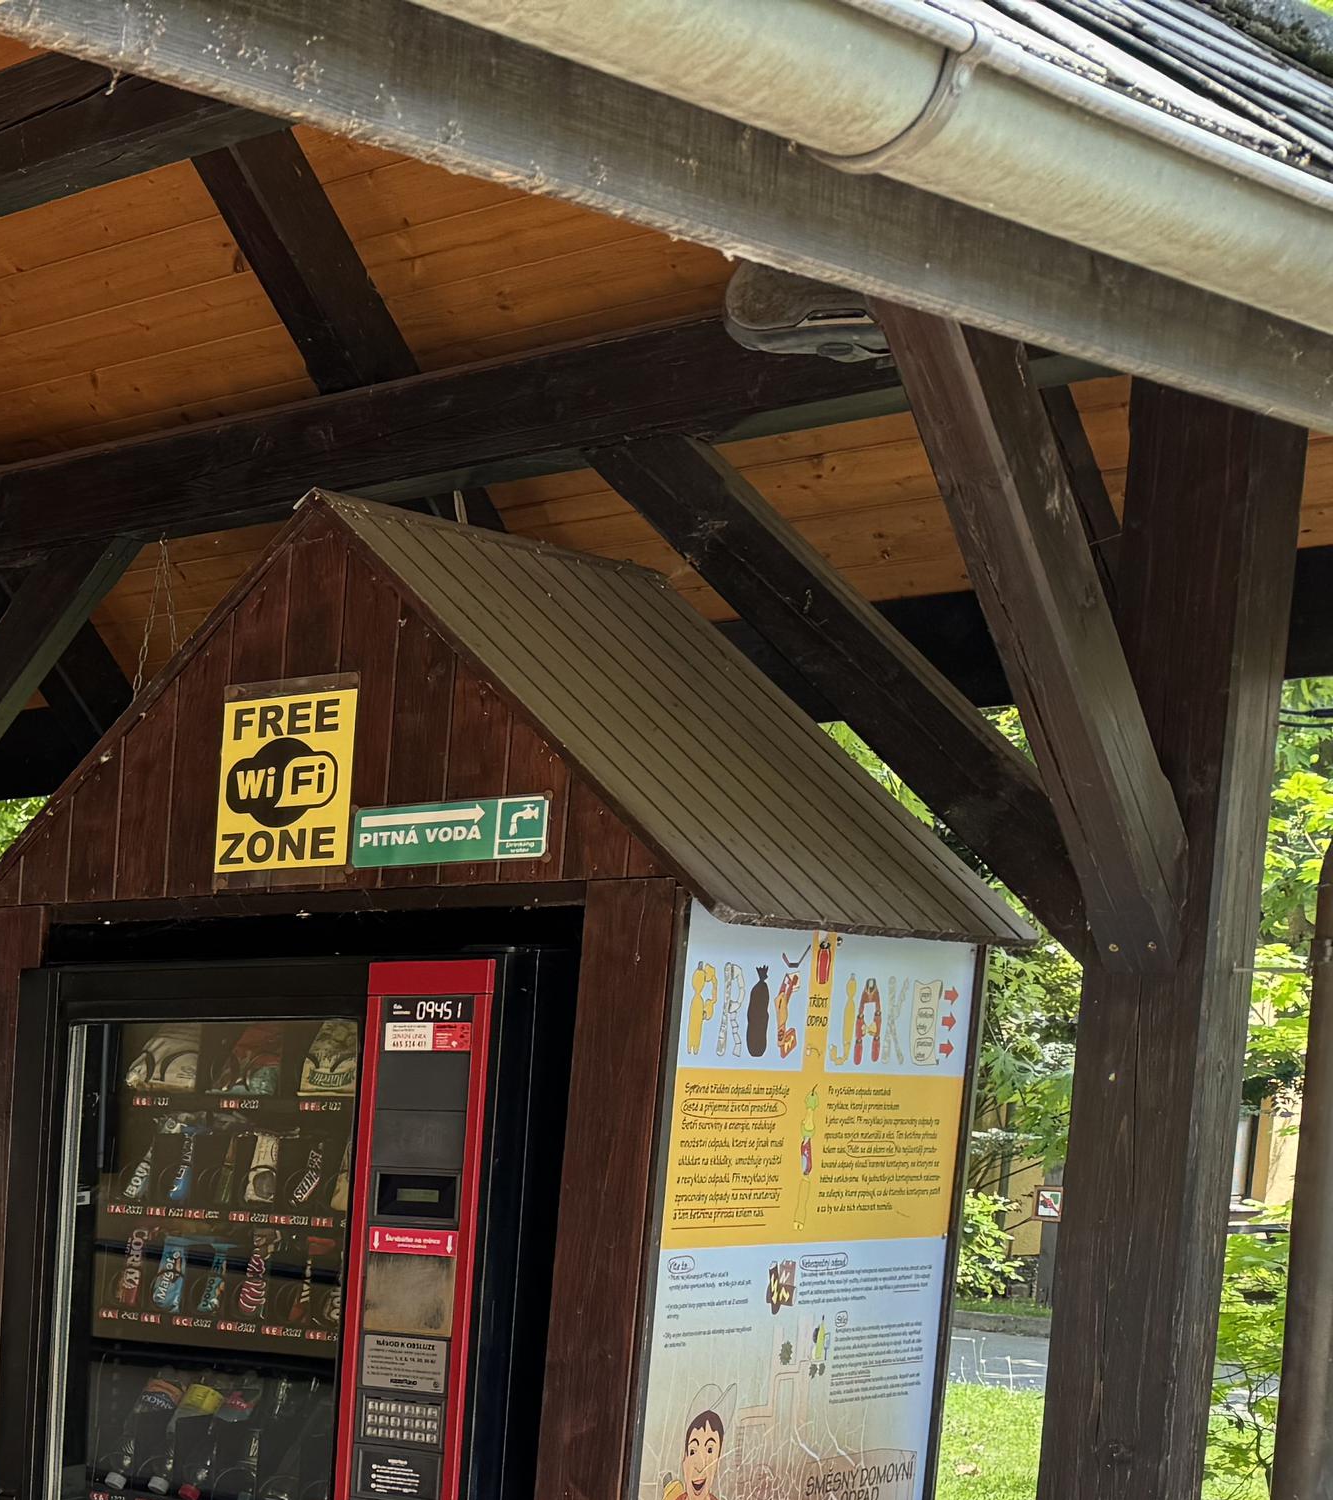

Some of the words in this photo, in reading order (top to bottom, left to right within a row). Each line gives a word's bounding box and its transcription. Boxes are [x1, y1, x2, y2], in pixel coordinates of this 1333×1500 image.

[233, 698, 340, 740] FREE
[219, 826, 335, 865] ZONE
[359, 825, 418, 847] PITNÁ
[426, 825, 481, 843] VODA
[860, 1455, 915, 1486] DOMOVNÍ
